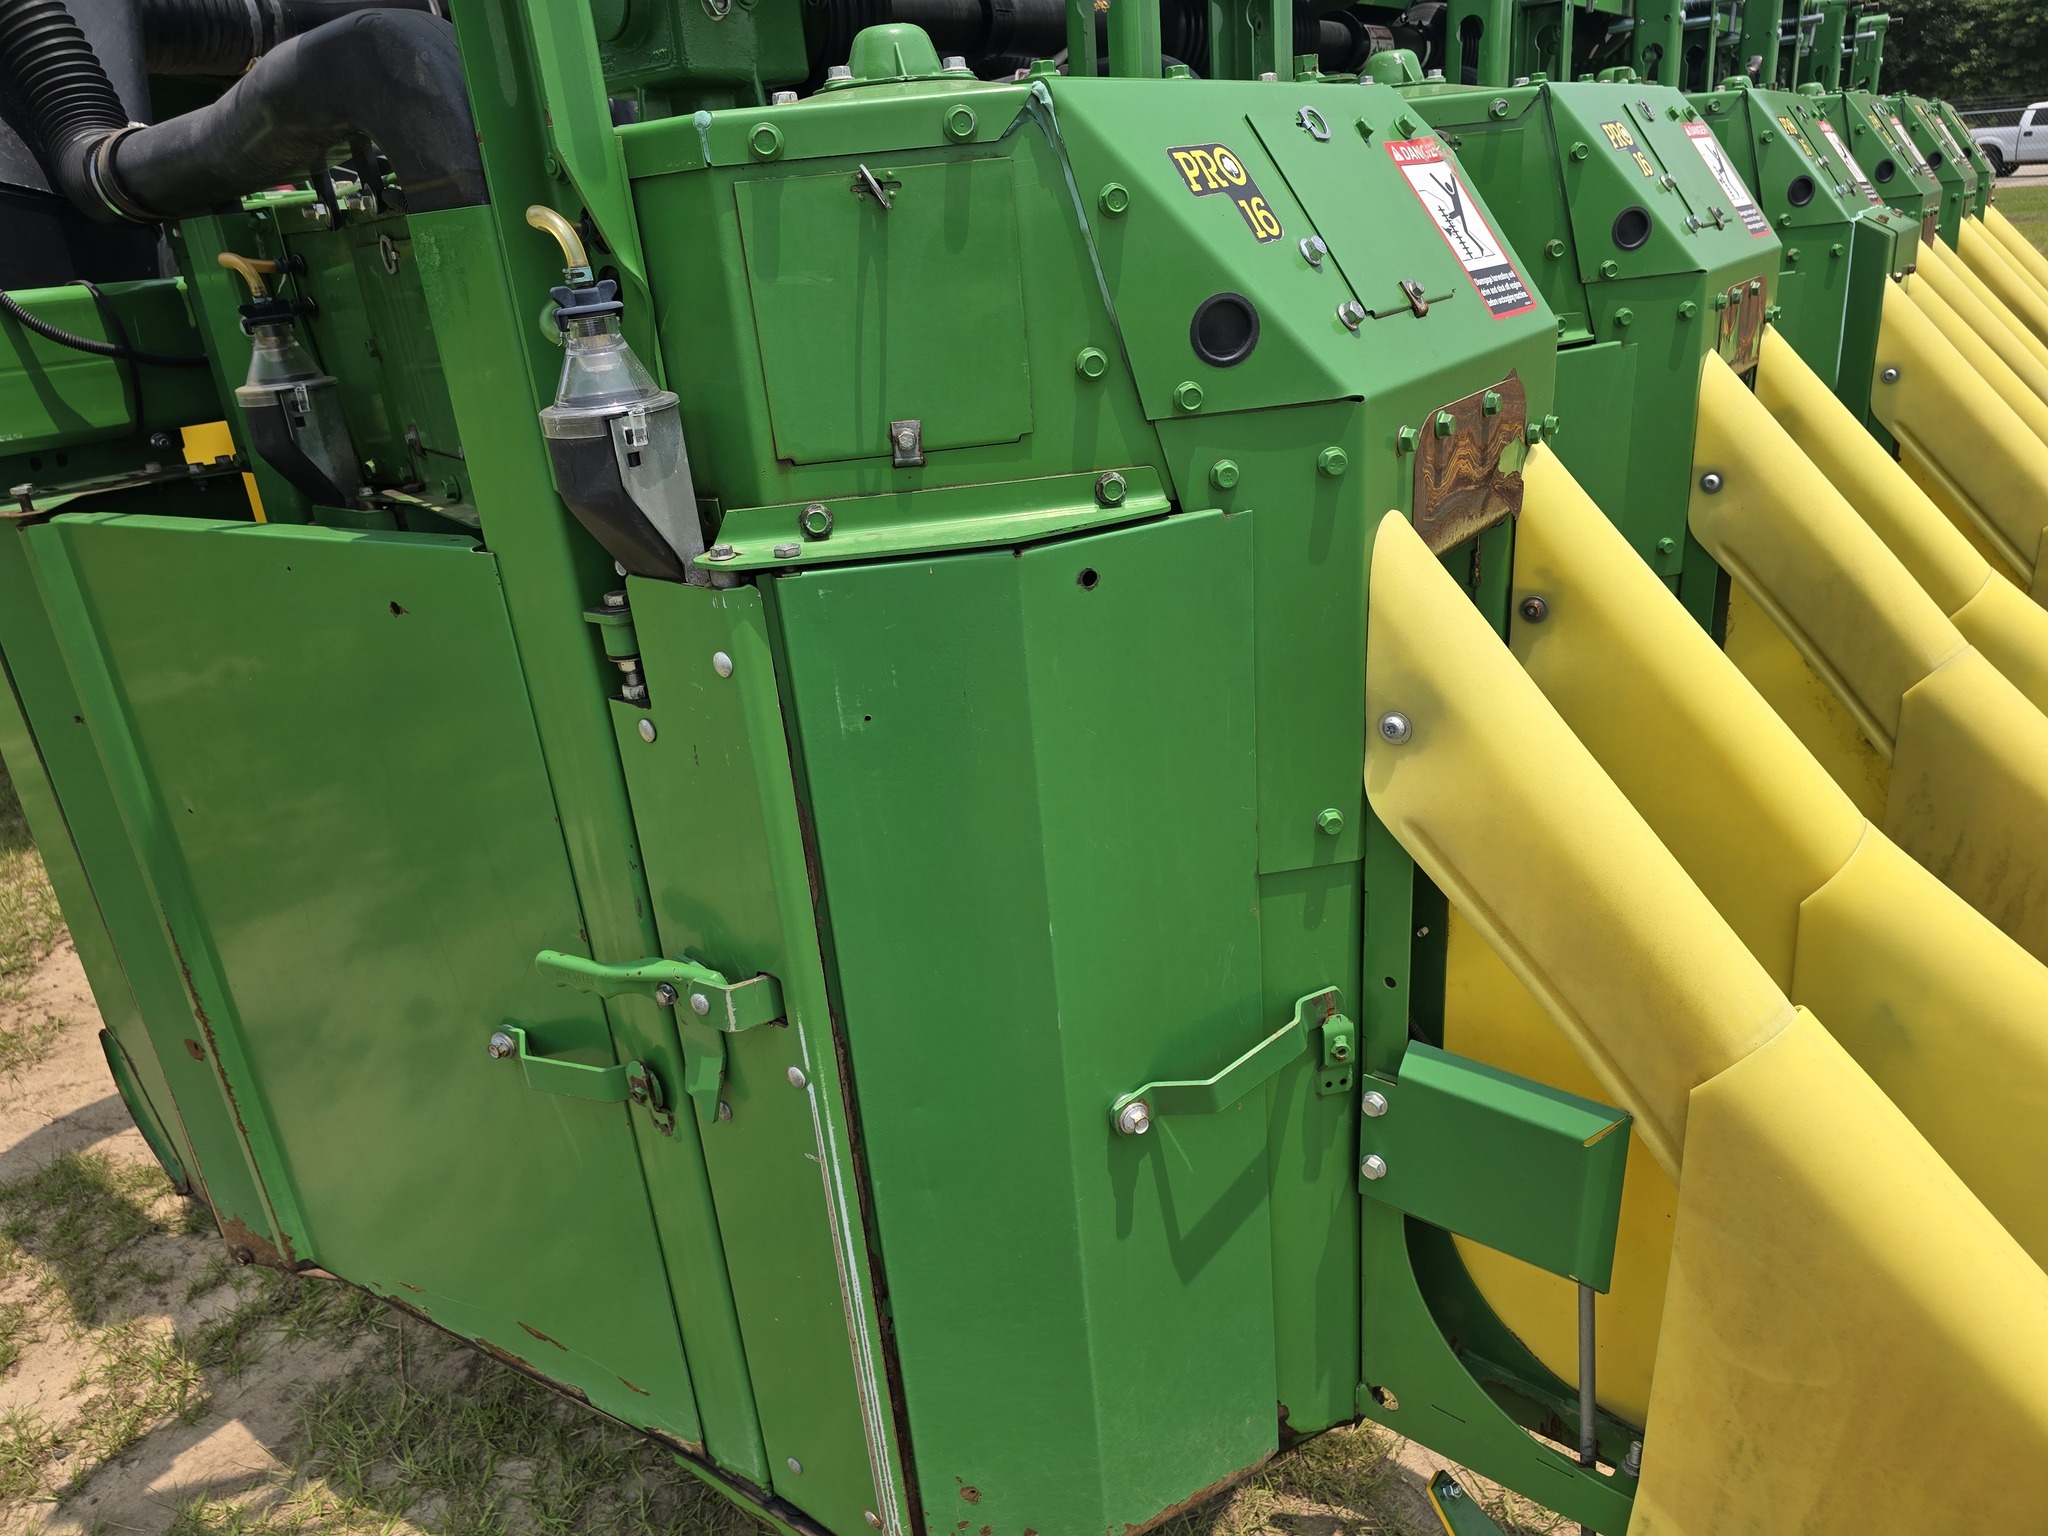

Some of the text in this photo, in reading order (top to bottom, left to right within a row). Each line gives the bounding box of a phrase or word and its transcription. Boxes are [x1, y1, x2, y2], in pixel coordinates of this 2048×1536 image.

[1602, 122, 1634, 148] PRO
[1172, 147, 1247, 191] PRO
[1633, 151, 1653, 176] 16
[1238, 197, 1280, 239] 16
